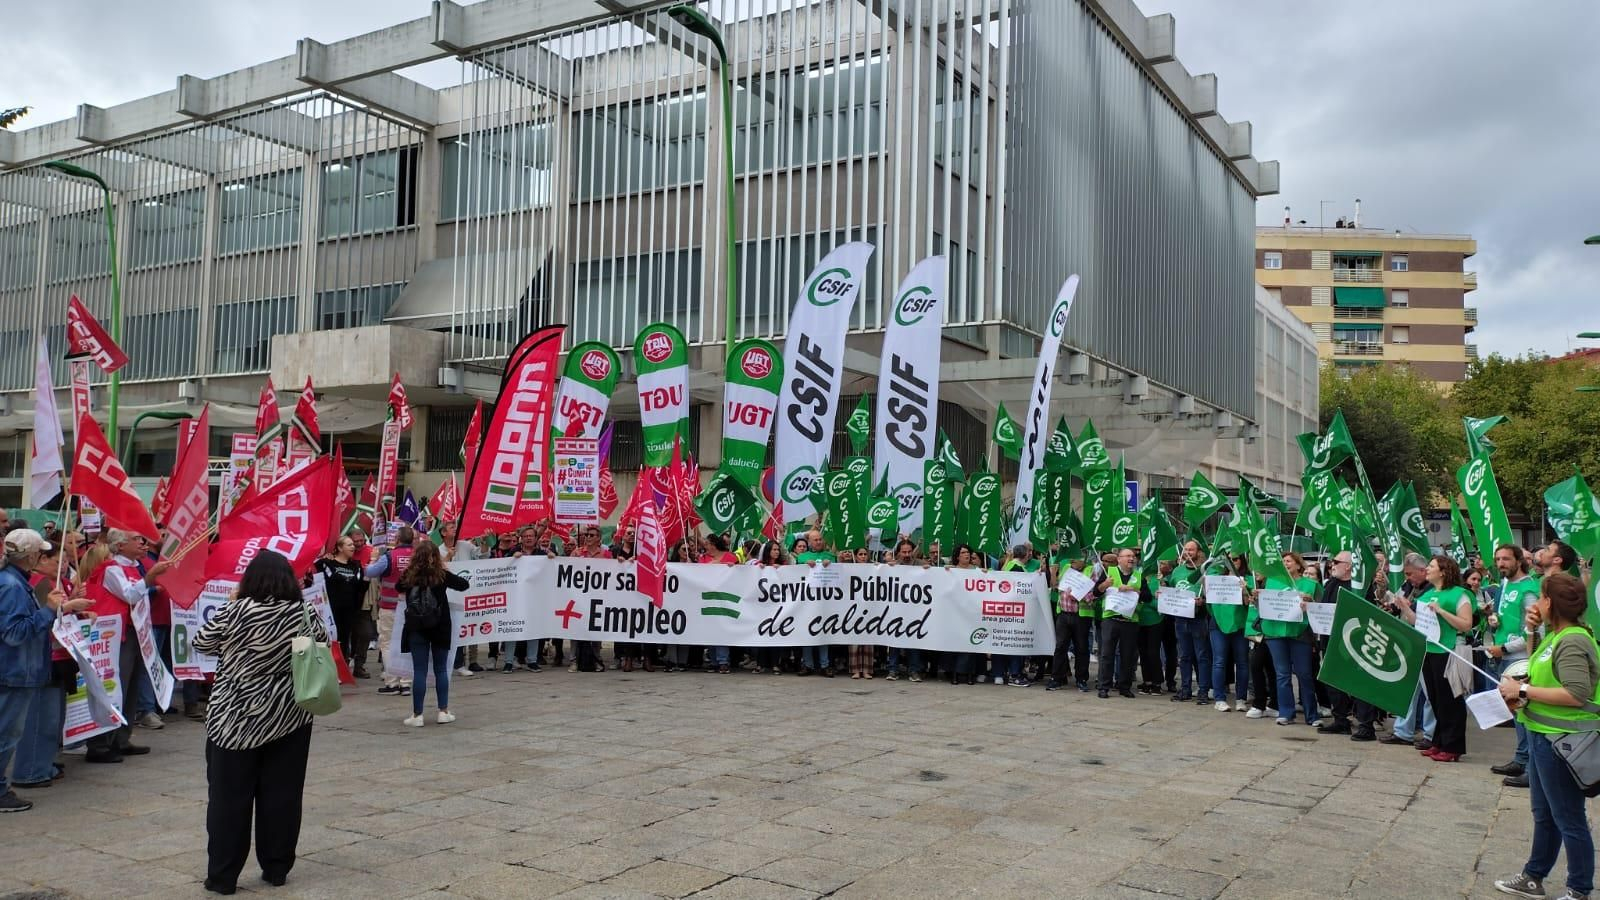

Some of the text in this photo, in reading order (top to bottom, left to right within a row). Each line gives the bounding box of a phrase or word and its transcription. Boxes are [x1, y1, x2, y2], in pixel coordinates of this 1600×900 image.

[817, 278, 854, 297] CSIF
[902, 298, 937, 313] CSIF
[586, 353, 609, 371] UGT
[748, 351, 773, 370] UGT
[787, 332, 835, 443] CSIF
[559, 395, 604, 428] UGT
[885, 352, 930, 459] CSIF
[489, 362, 547, 486] CCOO
[728, 402, 772, 429] UGT
[931, 468, 946, 478] CSI
[789, 476, 814, 492] CSI
[832, 479, 852, 490] CSIF
[978, 482, 998, 492] CSIF
[519, 502, 545, 511] órdoba
[717, 490, 736, 514] CSIF
[480, 513, 513, 526] Córdoba
[873, 507, 895, 518] CSIF
[1092, 497, 1104, 546] CSIF
[839, 498, 853, 548] CSIF
[978, 500, 991, 549] CSIF
[1115, 525, 1135, 536] CSIF
[557, 564, 611, 593] Mejor
[965, 579, 996, 593] UGT
[758, 576, 844, 604] Servicios
[849, 575, 934, 605] Públicos
[467, 594, 505, 609] CCOO
[985, 603, 1024, 614] CCOO
[588, 598, 687, 640] Empleo
[758, 604, 932, 640] de calidad
[1360, 617, 1390, 667] CSIF
